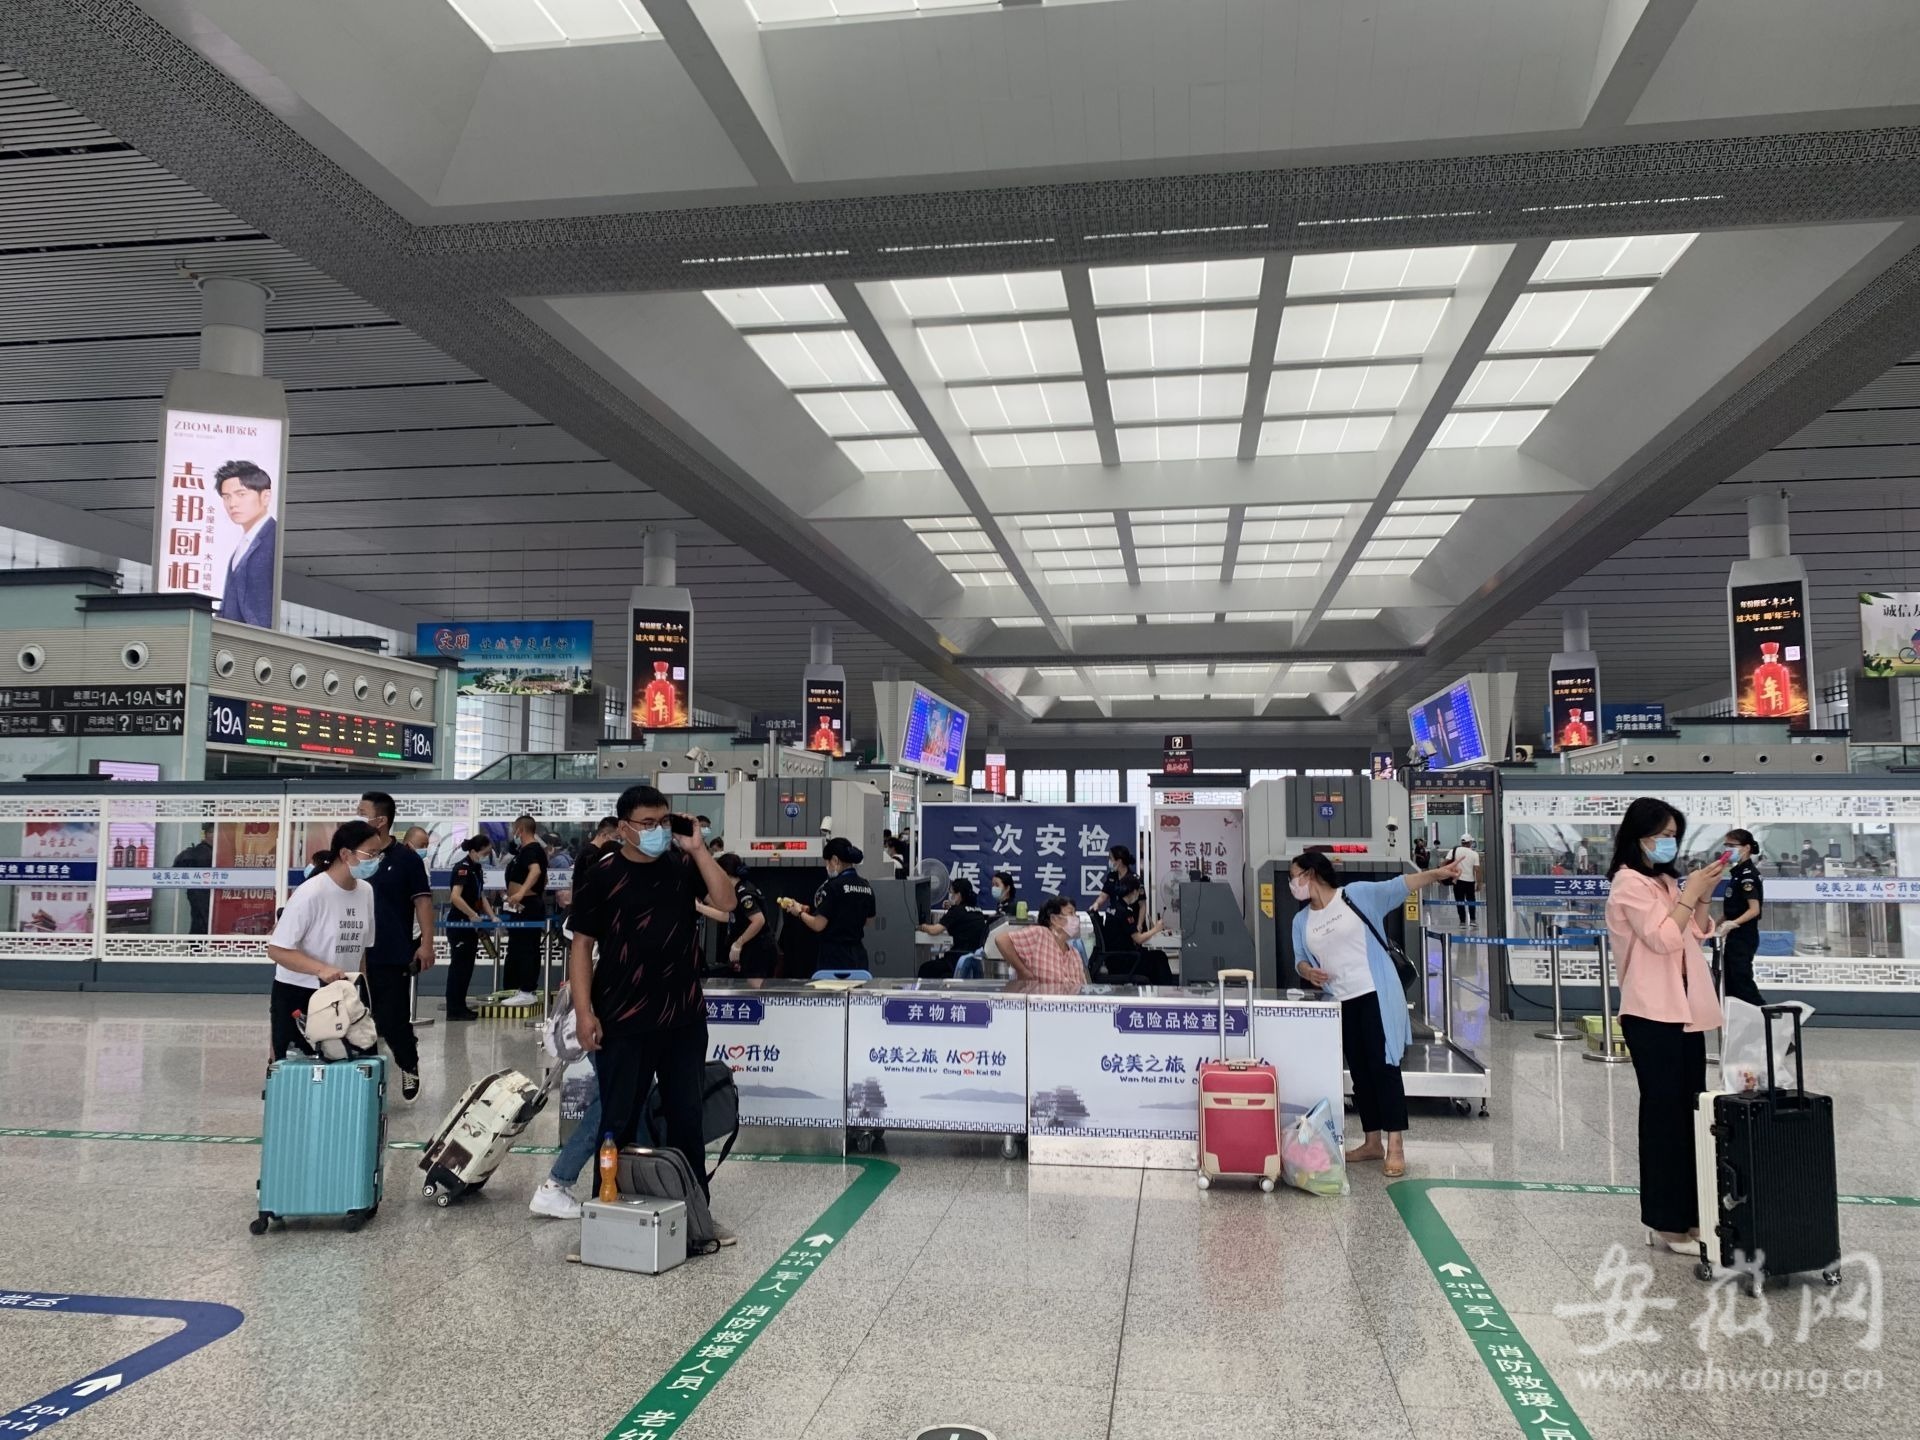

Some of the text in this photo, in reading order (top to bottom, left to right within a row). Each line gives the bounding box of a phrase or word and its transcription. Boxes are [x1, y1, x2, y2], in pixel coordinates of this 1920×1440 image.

[175, 421, 210, 432] ZBOM
[167, 461, 205, 591] 志邦厨柜
[438, 631, 470, 649] 文明
[13, 690, 153, 706] 卫生间 检票口 1A-19A
[88, 717, 114, 726] 问询处
[136, 716, 153, 725] 出口
[212, 705, 244, 736] 19A
[412, 733, 431, 756] 18A
[950, 824, 1110, 858] 二次安检
[1169, 842, 1227, 857] 不忘初心
[235, 853, 275, 868] 热烈庆祝
[25, 864, 71, 874] 请您配合
[1554, 880, 1611, 890] 二次安检
[222, 889, 277, 900] 成立100周
[346, 908, 355, 917] WE
[339, 920, 364, 929] SHOULD
[340, 932, 360, 941] ALL BE
[908, 1004, 967, 1023] 弃物箱
[1129, 1010, 1235, 1031] 危险品检查台
[869, 1046, 939, 1064] 皖美之旅
[1101, 1053, 1186, 1074] 皖美之旅
[1158, 1076, 1173, 1084] Zhi
[1174, 1076, 1185, 1084] Lv
[779, 1259, 815, 1267] 21A
[1445, 1282, 1485, 1290] 20B
[1451, 1291, 1492, 1299] 21B
[20, 1405, 70, 1417] 20A
